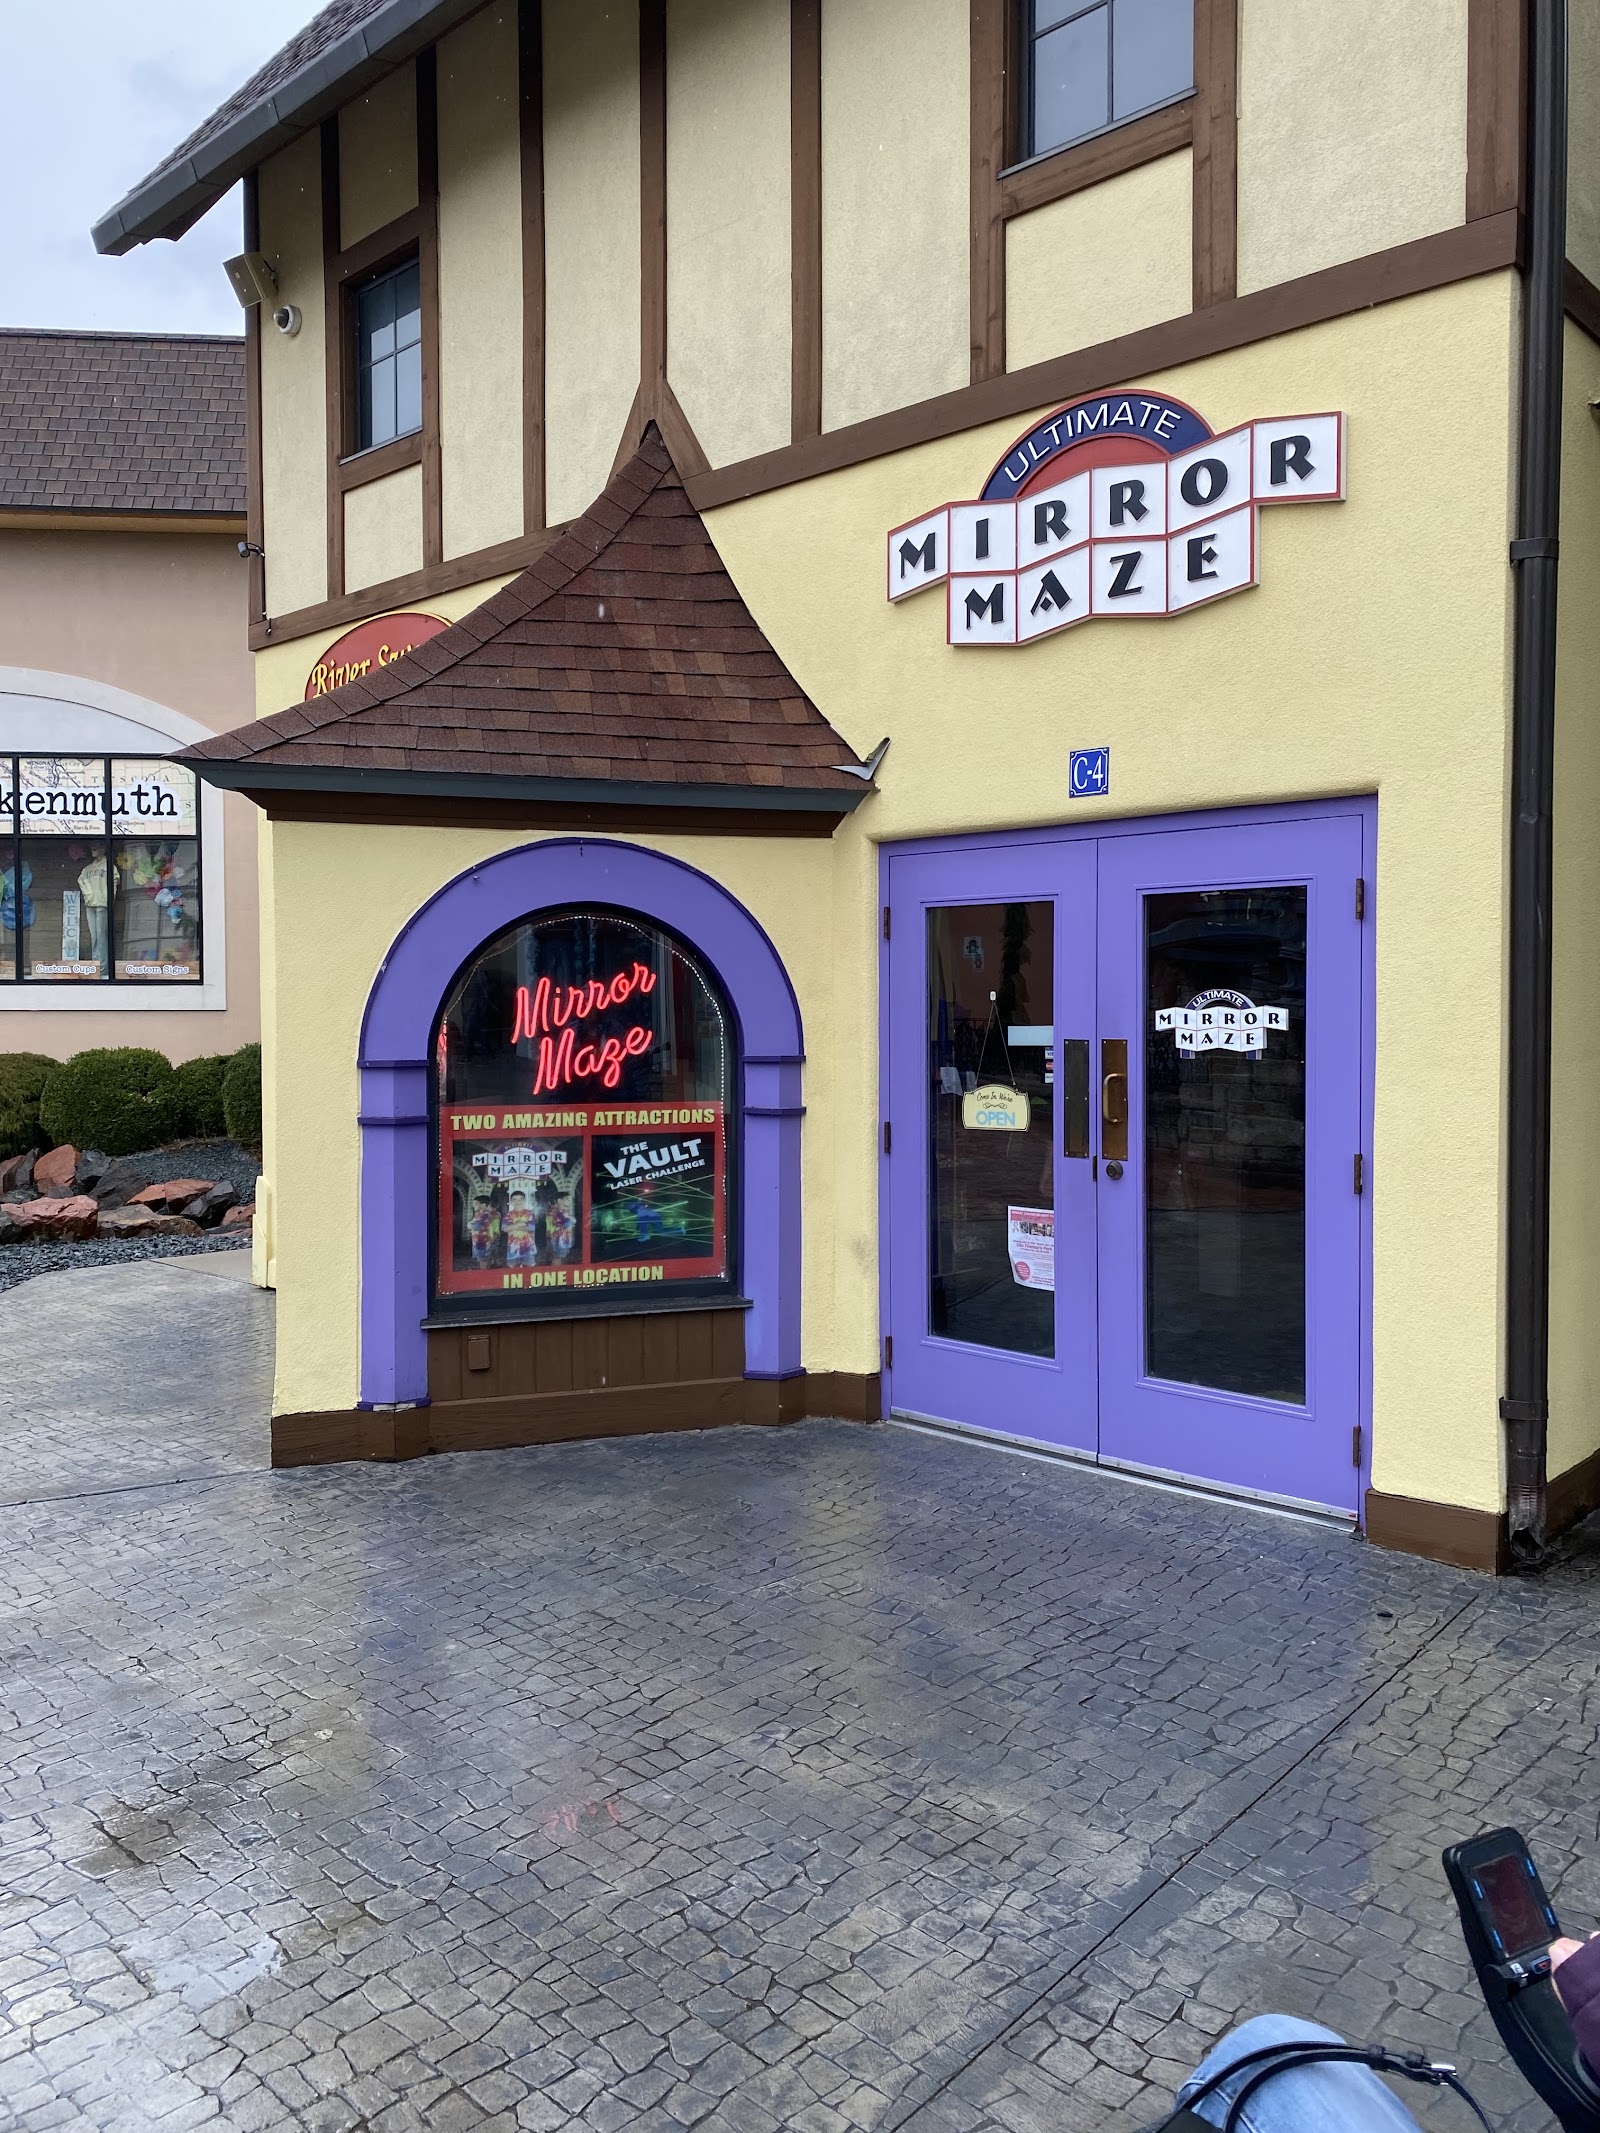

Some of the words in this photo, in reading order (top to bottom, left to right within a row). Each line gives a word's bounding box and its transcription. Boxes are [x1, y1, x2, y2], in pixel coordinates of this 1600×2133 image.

[1003, 400, 1183, 484] ULTIMATE
[898, 433, 1316, 580] MIRROR
[964, 532, 1218, 630] MAZE
[312, 659, 371, 698] River
[1074, 755, 1104, 790] C-4
[36, 965, 71, 974] Custom
[74, 965, 96, 976] Cups
[126, 965, 162, 974] Custom
[164, 965, 189, 976] Signs
[510, 962, 657, 1045] Mirror
[1191, 989, 1245, 1008] ULTIMATE
[1159, 1012, 1281, 1025] MIRROR
[1180, 1032, 1256, 1045] MAZE
[533, 1026, 653, 1096] Maze
[976, 1092, 990, 1102] Come
[450, 1114, 496, 1131] TWO
[502, 1111, 588, 1129] AMAZING
[593, 1108, 715, 1127] ATTRACTIONS
[975, 1110, 1016, 1127] OPEN
[474, 1153, 563, 1165] MIRROR
[603, 1138, 702, 1179] VAULT
[620, 1141, 649, 1156] THE
[490, 1165, 547, 1175] MAZE
[610, 1175, 643, 1191] LASER
[645, 1158, 706, 1181] CHALLENGE
[503, 1273, 524, 1289] IN
[530, 1271, 567, 1288] ONE
[573, 1265, 664, 1285] LOCATION
